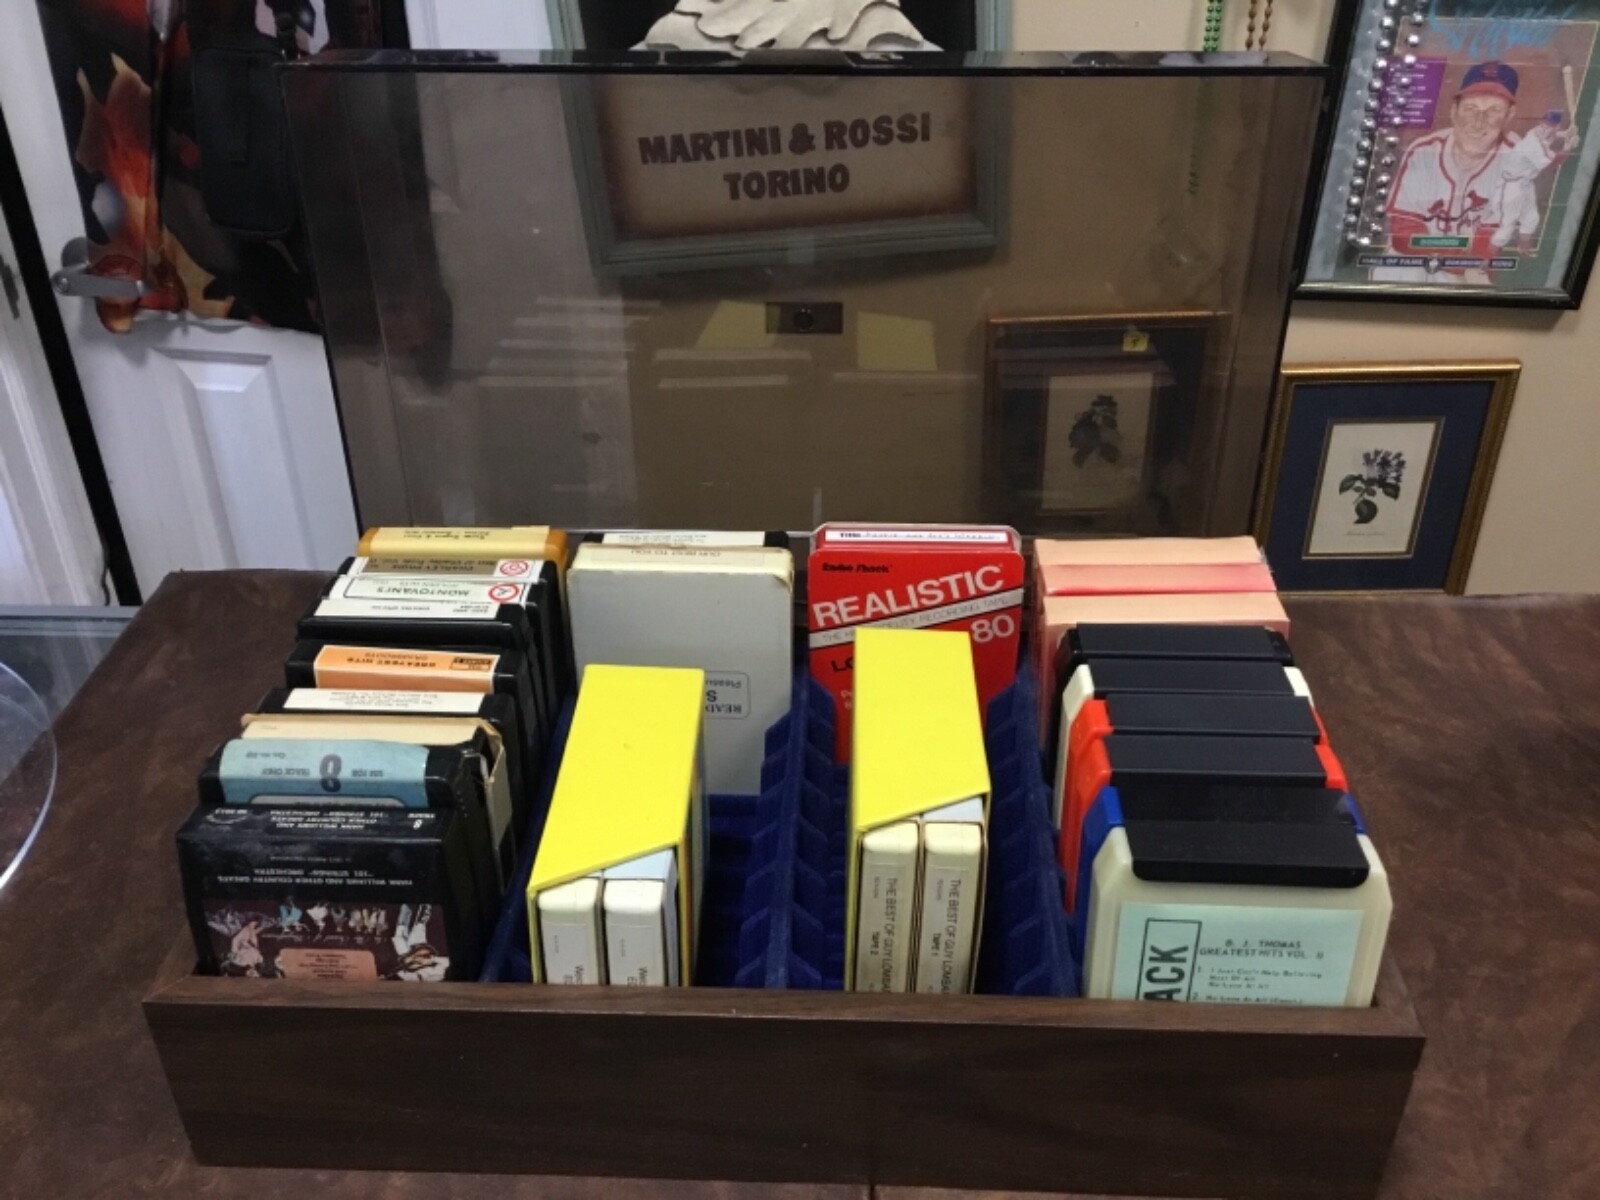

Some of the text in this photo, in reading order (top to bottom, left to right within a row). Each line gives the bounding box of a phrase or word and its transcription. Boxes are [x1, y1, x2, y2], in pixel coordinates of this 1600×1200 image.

[637, 112, 931, 164] MARTINI & ROSSI
[723, 163, 850, 200] TORINO
[812, 565, 1004, 627] REALISTIC
[970, 614, 1014, 643] 80
[377, 660, 436, 668] GREATEST
[705, 680, 742, 689] Pleasu
[705, 704, 742, 714] READ
[319, 754, 342, 793] 8
[352, 768, 367, 777] FOR
[412, 819, 424, 830] 8
[871, 931, 880, 950] TAPE
[882, 877, 898, 992] THE BEST OF GUY LOMBA
[931, 932, 942, 951] TAPE
[941, 879, 961, 993] THE BEST OF GUY LOMBA
[1200, 948, 1256, 958] GREATEST
[1258, 949, 1284, 958] HITS
[1258, 940, 1301, 949] THOMAS
[1143, 945, 1189, 1001] ACK
